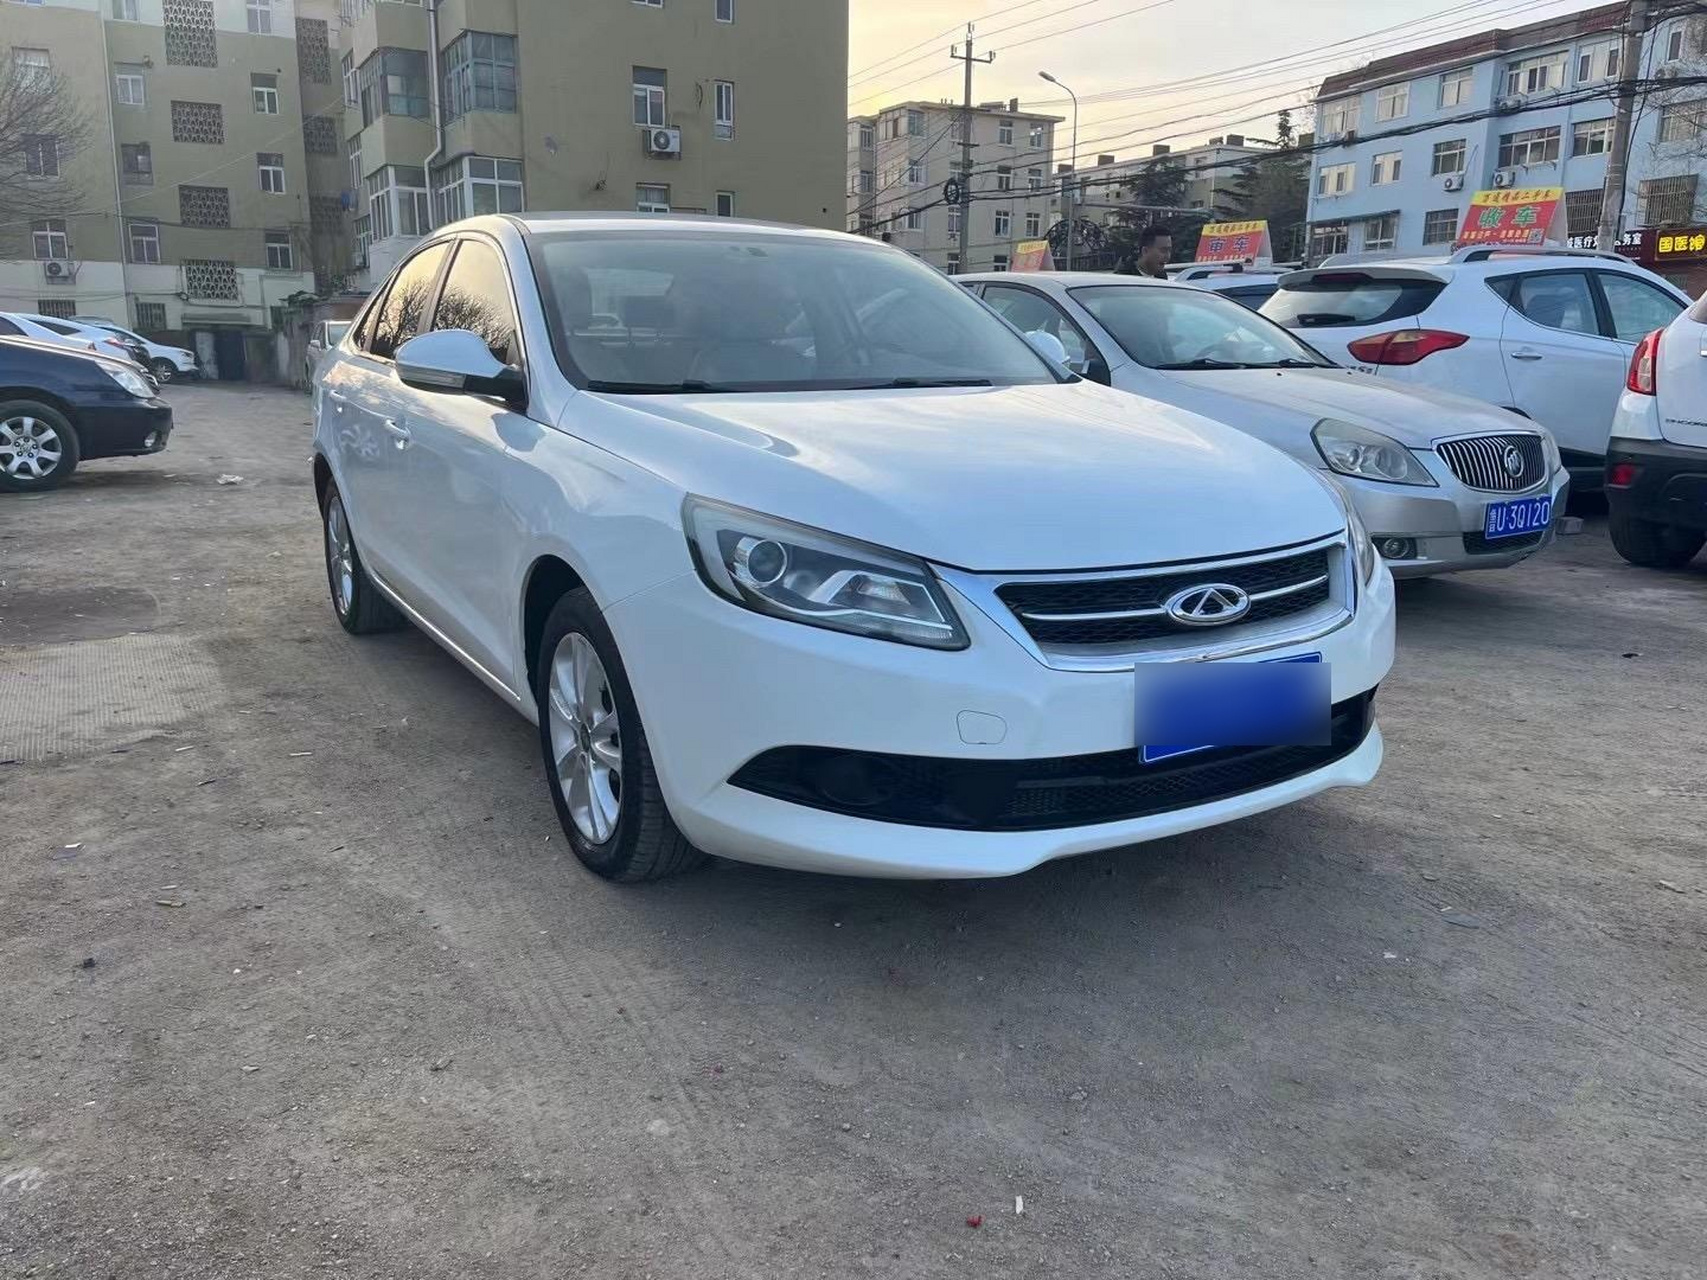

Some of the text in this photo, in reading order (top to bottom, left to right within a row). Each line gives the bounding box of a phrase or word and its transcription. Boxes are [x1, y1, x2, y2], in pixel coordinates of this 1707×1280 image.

[1208, 235, 1250, 253] 审车
[1658, 234, 1705, 253] 国医馆
